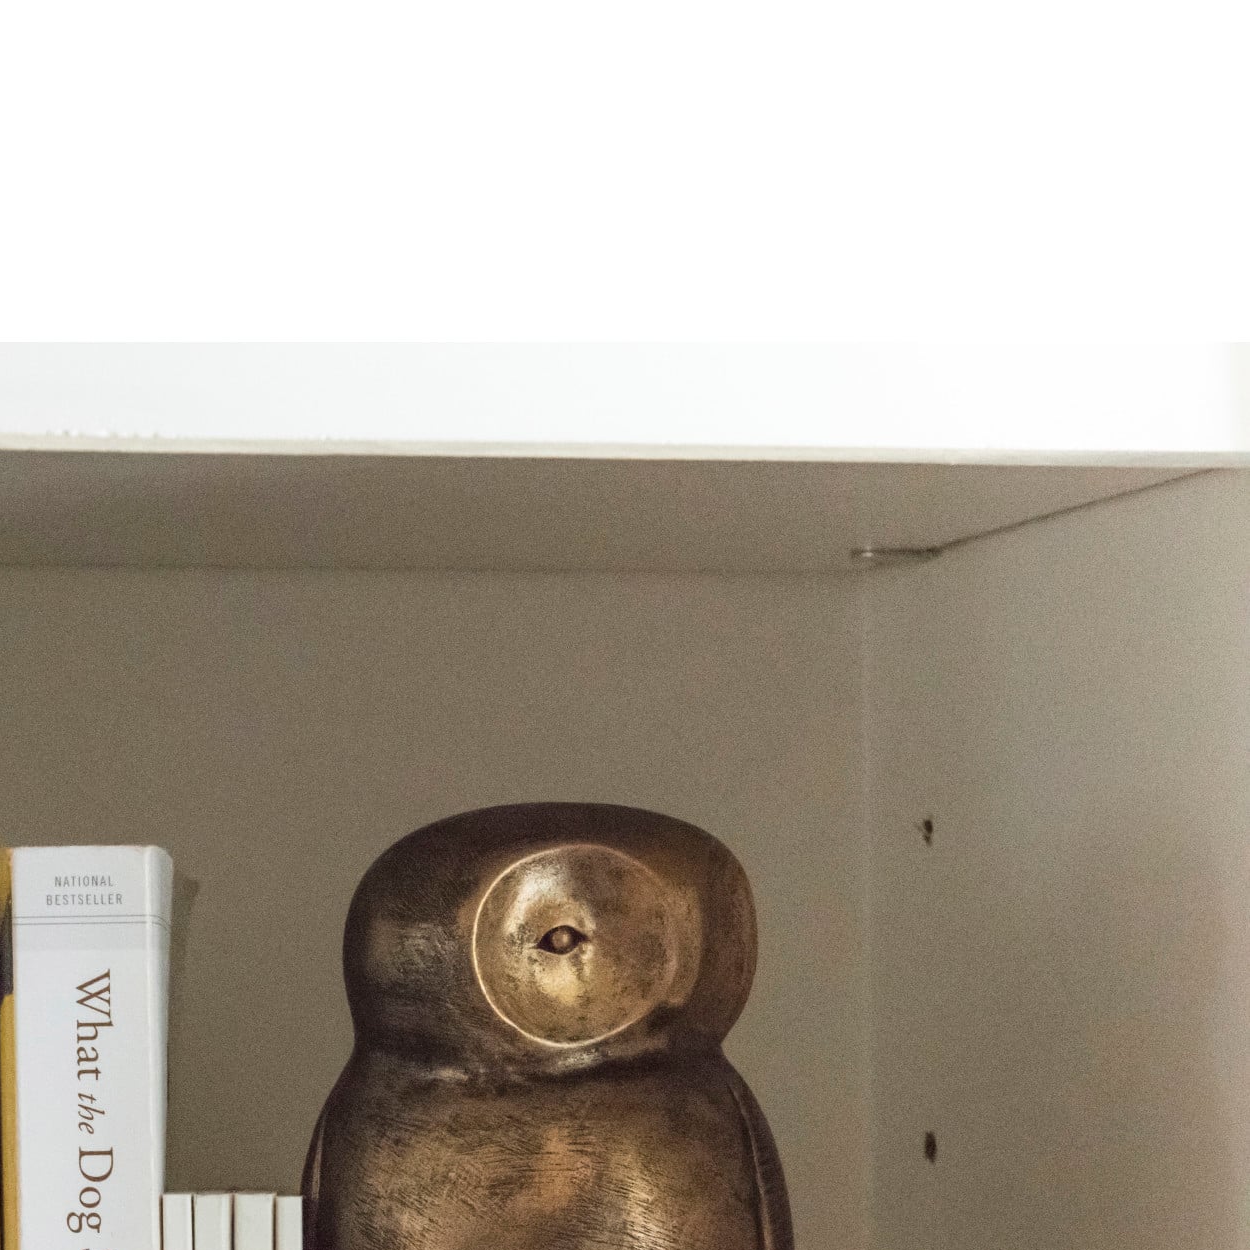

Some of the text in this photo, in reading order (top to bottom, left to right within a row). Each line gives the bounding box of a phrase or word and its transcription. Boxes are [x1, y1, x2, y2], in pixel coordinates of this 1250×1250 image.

[46, 893, 123, 906] BESTSELLER
[54, 875, 114, 888] NATIONAL
[75, 968, 114, 1081] What
[77, 1092, 106, 1135] the
[66, 1146, 114, 1234] Dog
